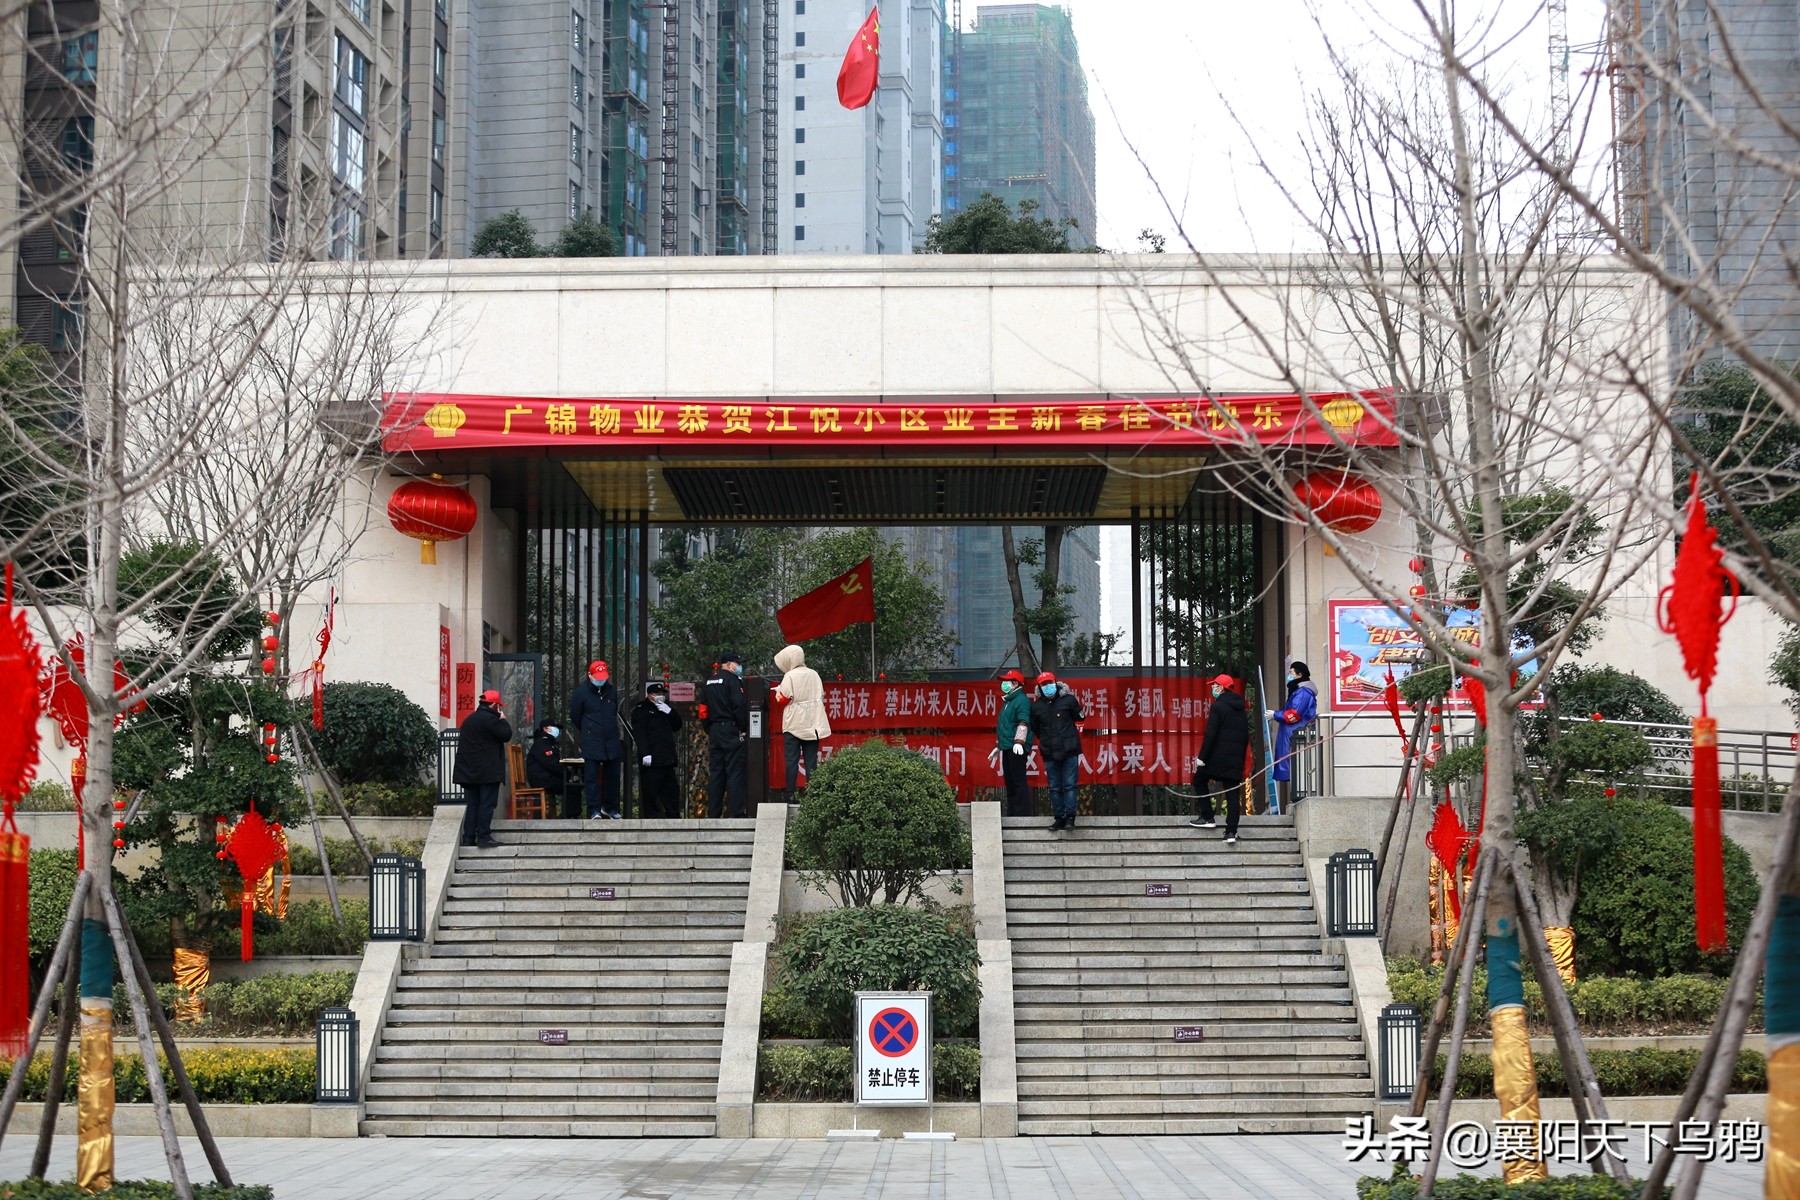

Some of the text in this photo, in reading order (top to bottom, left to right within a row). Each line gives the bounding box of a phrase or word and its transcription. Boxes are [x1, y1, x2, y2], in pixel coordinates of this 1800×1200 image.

[457, 667, 474, 710] 防控
[868, 1067, 920, 1087] 禁止停车
